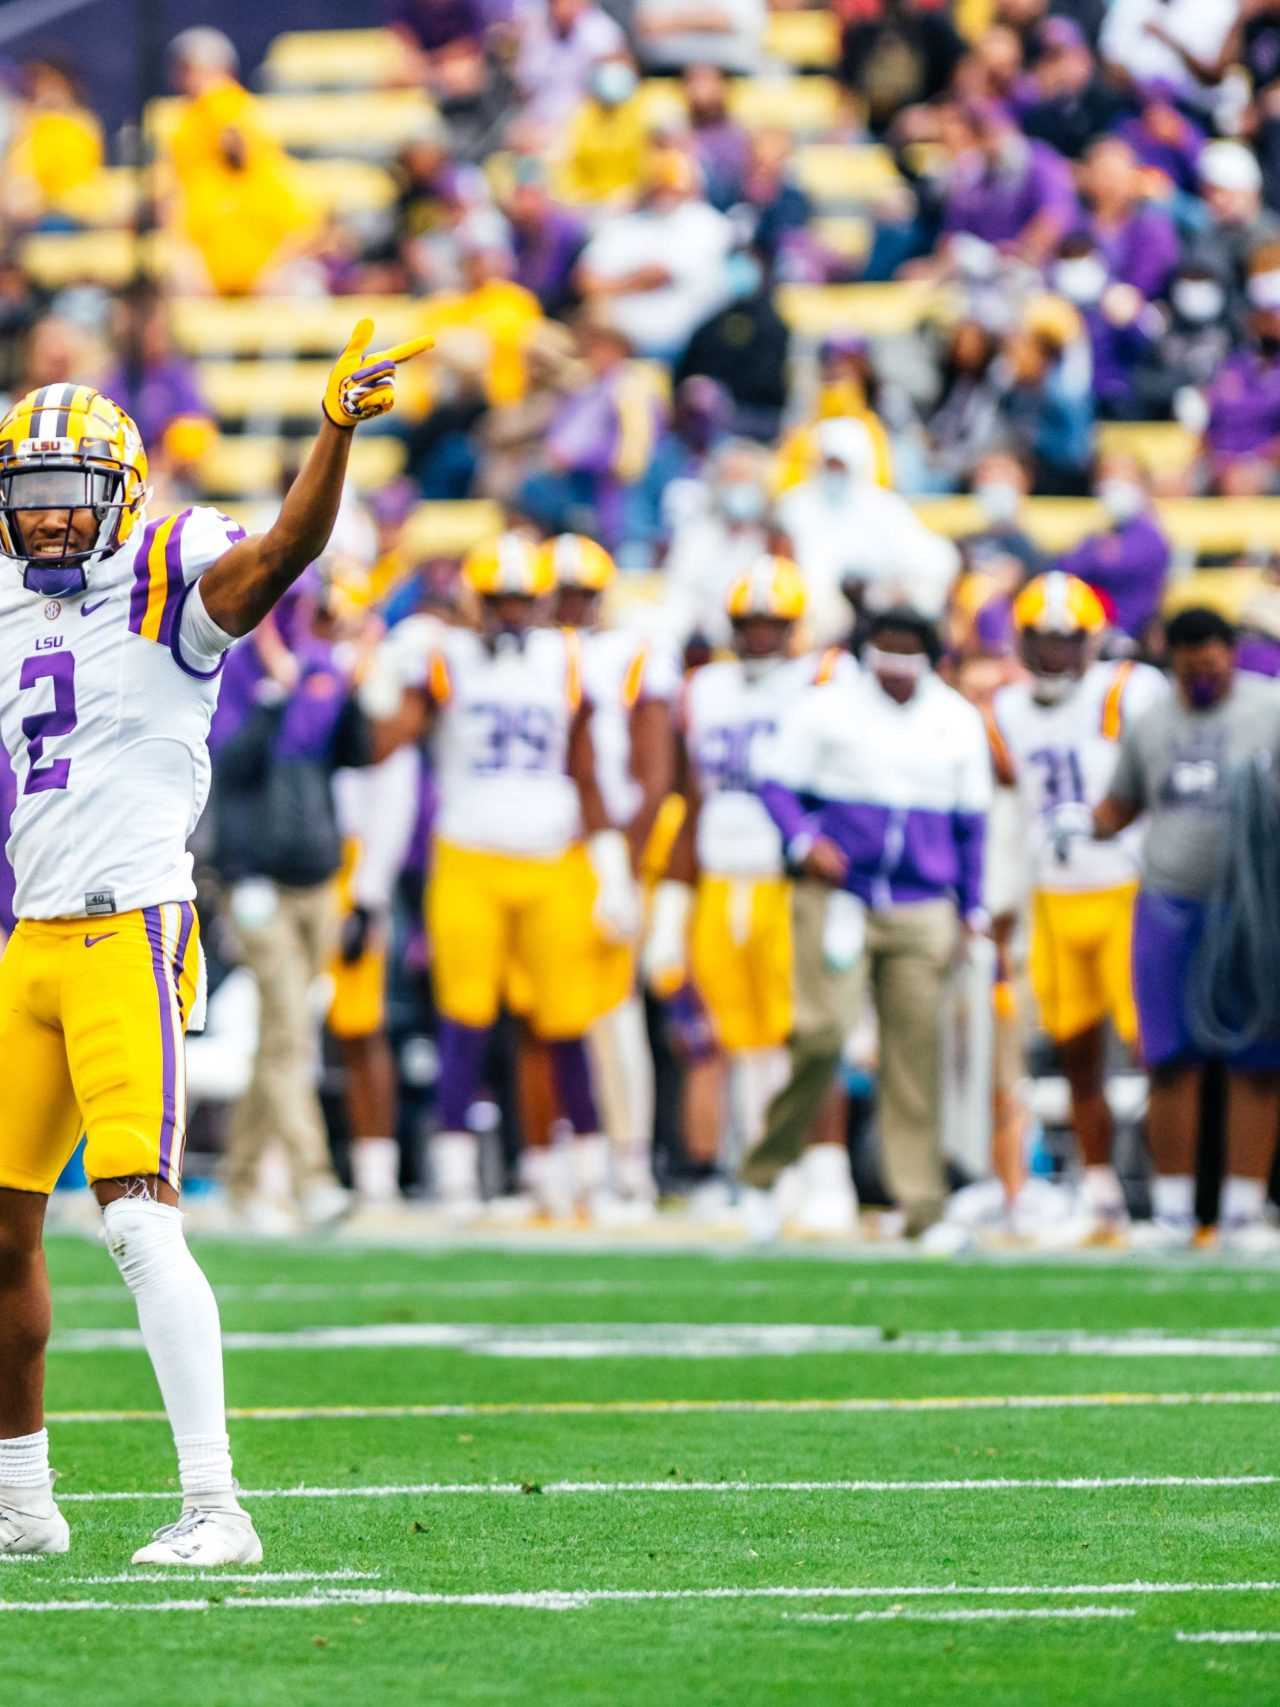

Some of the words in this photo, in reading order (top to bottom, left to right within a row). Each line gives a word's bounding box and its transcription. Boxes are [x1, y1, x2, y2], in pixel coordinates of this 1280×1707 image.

[31, 441, 61, 452] LSU
[35, 635, 64, 651] LSU
[19, 650, 78, 795] 2
